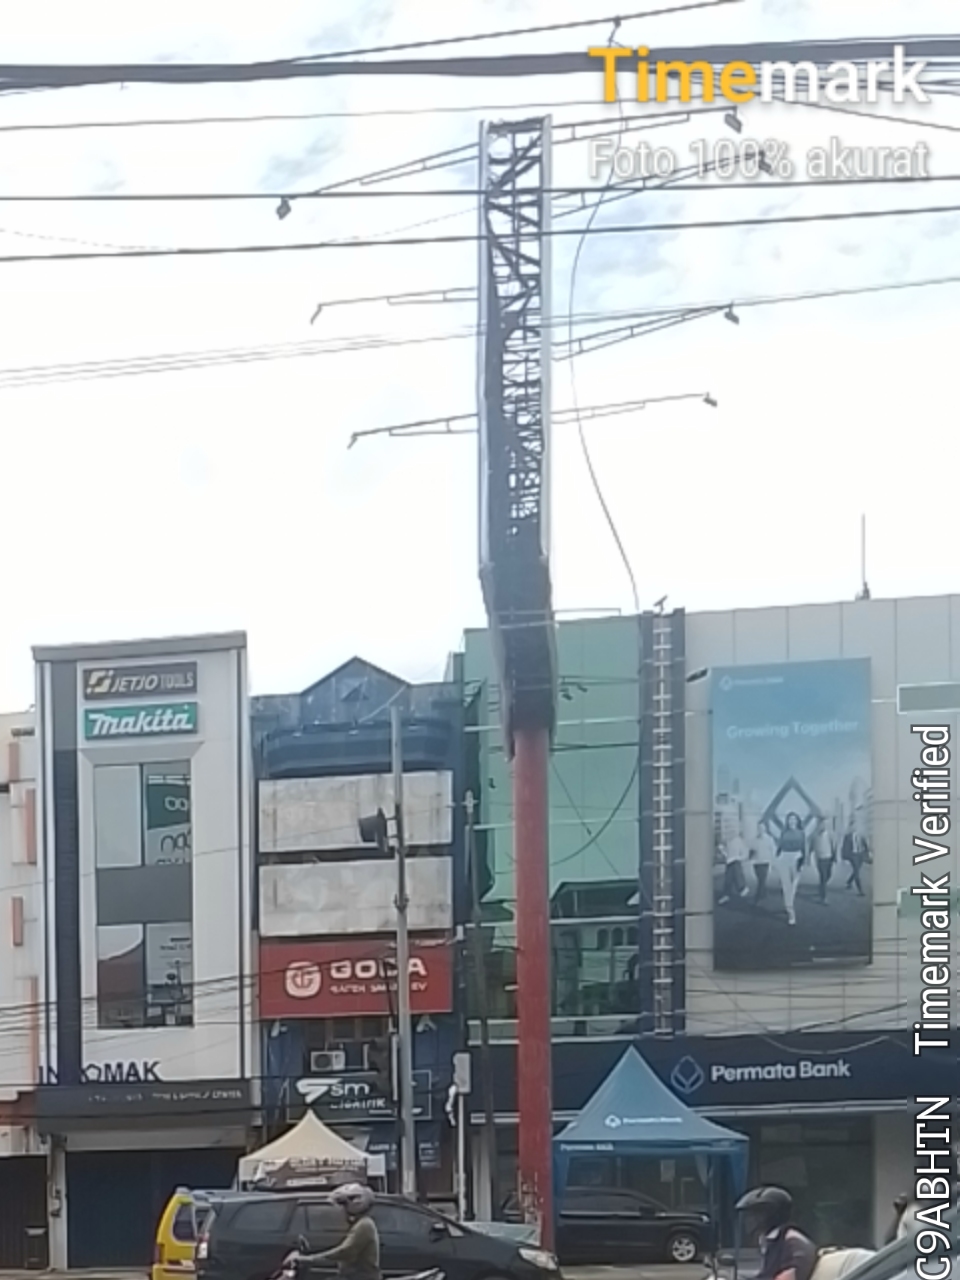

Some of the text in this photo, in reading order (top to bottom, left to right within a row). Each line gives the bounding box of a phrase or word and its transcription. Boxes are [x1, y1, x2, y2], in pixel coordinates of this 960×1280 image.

[726, 719, 859, 739] Growing Together
[711, 1059, 851, 1082] Permata Bank
